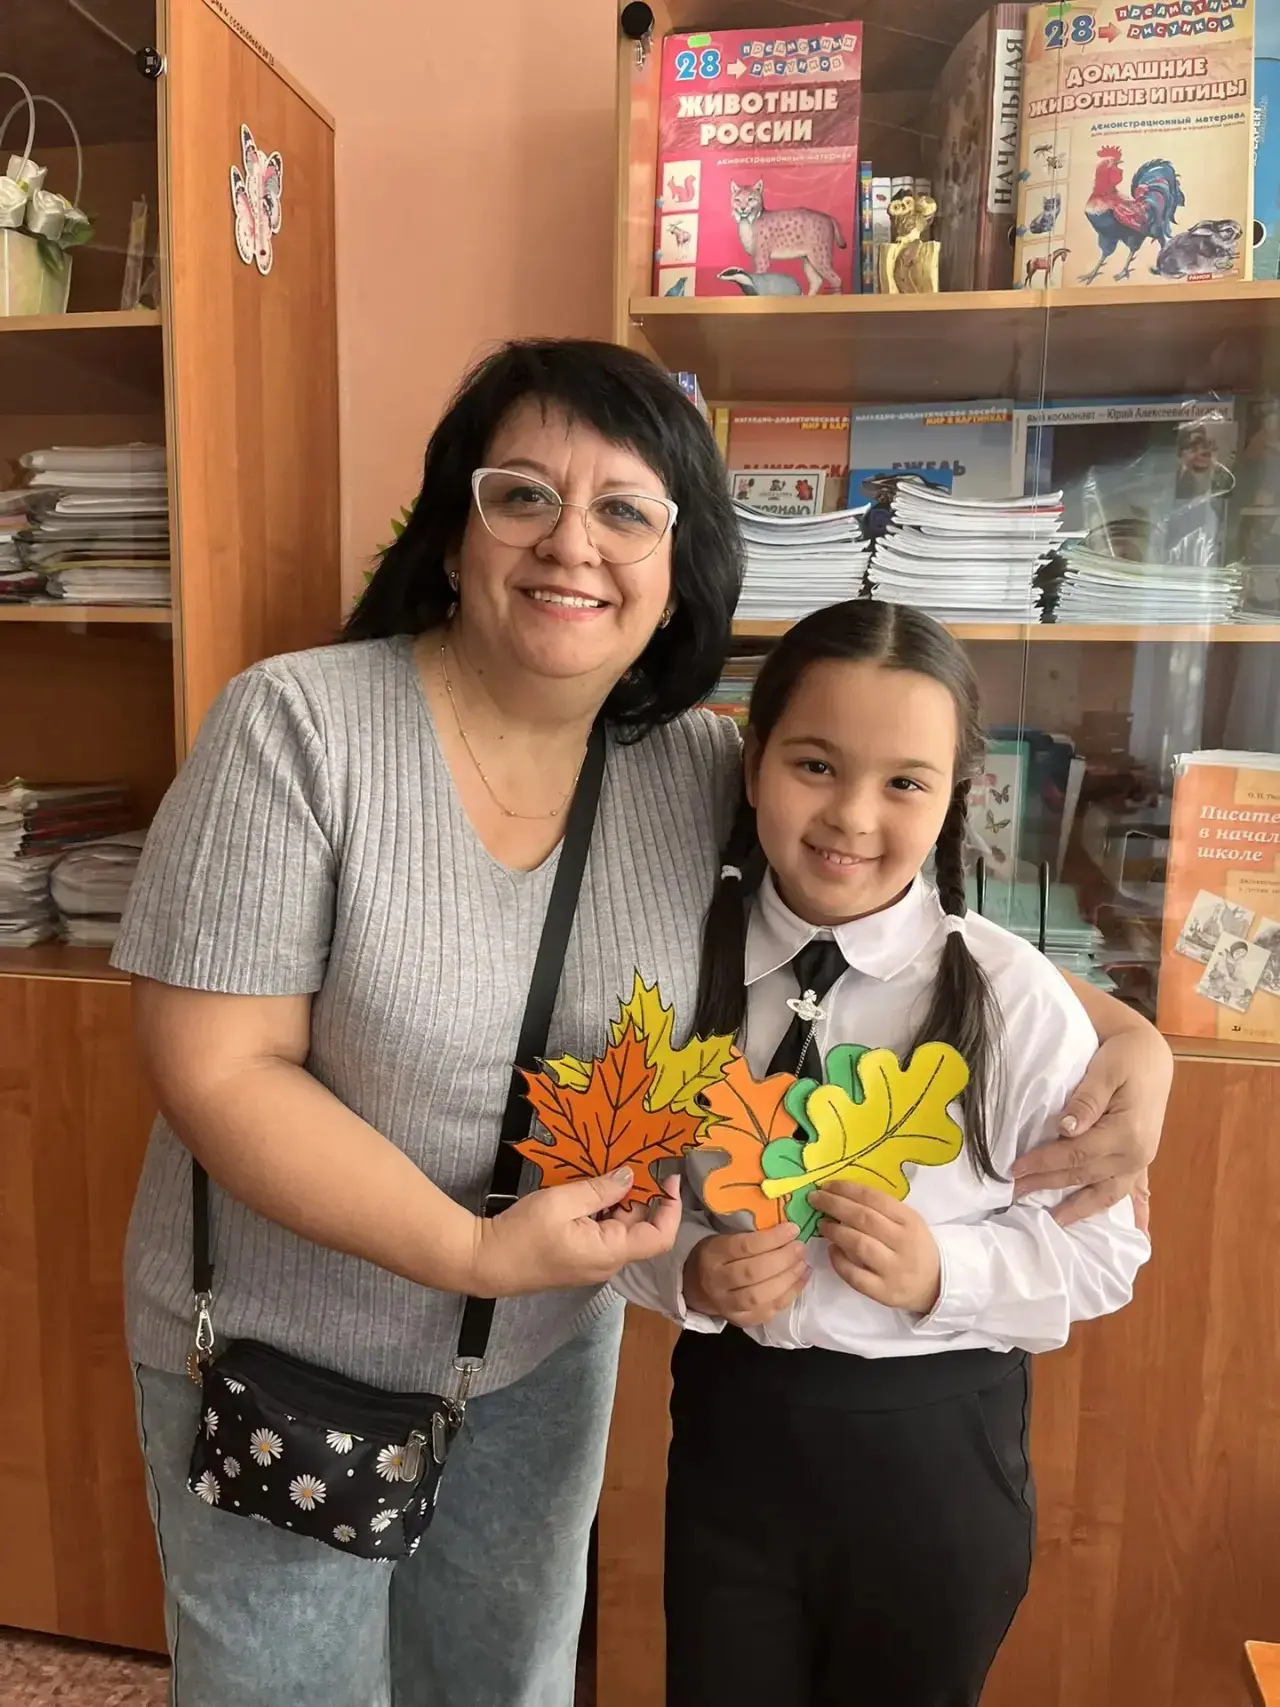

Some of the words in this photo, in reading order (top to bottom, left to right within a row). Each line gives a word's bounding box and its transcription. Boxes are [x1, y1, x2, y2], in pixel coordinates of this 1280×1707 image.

[1044, 14, 1096, 51] 28
[1128, 16, 1232, 37] рисунков
[675, 48, 721, 81] 28
[1065, 57, 1208, 88] ДОМАШНИЕ
[677, 88, 839, 119] ЖИВОТНЫЕ
[1028, 88, 1147, 118] ЖИВОТНЫЕ
[1150, 87, 1167, 104] И
[1170, 79, 1247, 103] ПТИЦЫ
[701, 119, 813, 146] РОССИИ
[994, 37, 1024, 205] НАЧАЛЬНАЯ
[1090, 116, 1192, 131] демонстрационный
[1195, 112, 1246, 124] материал
[1106, 407, 1134, 420] Юрий
[1199, 805, 1280, 824] Писате
[1199, 827, 1210, 839] в
[1216, 828, 1280, 843] начал
[1197, 846, 1263, 862] школе
